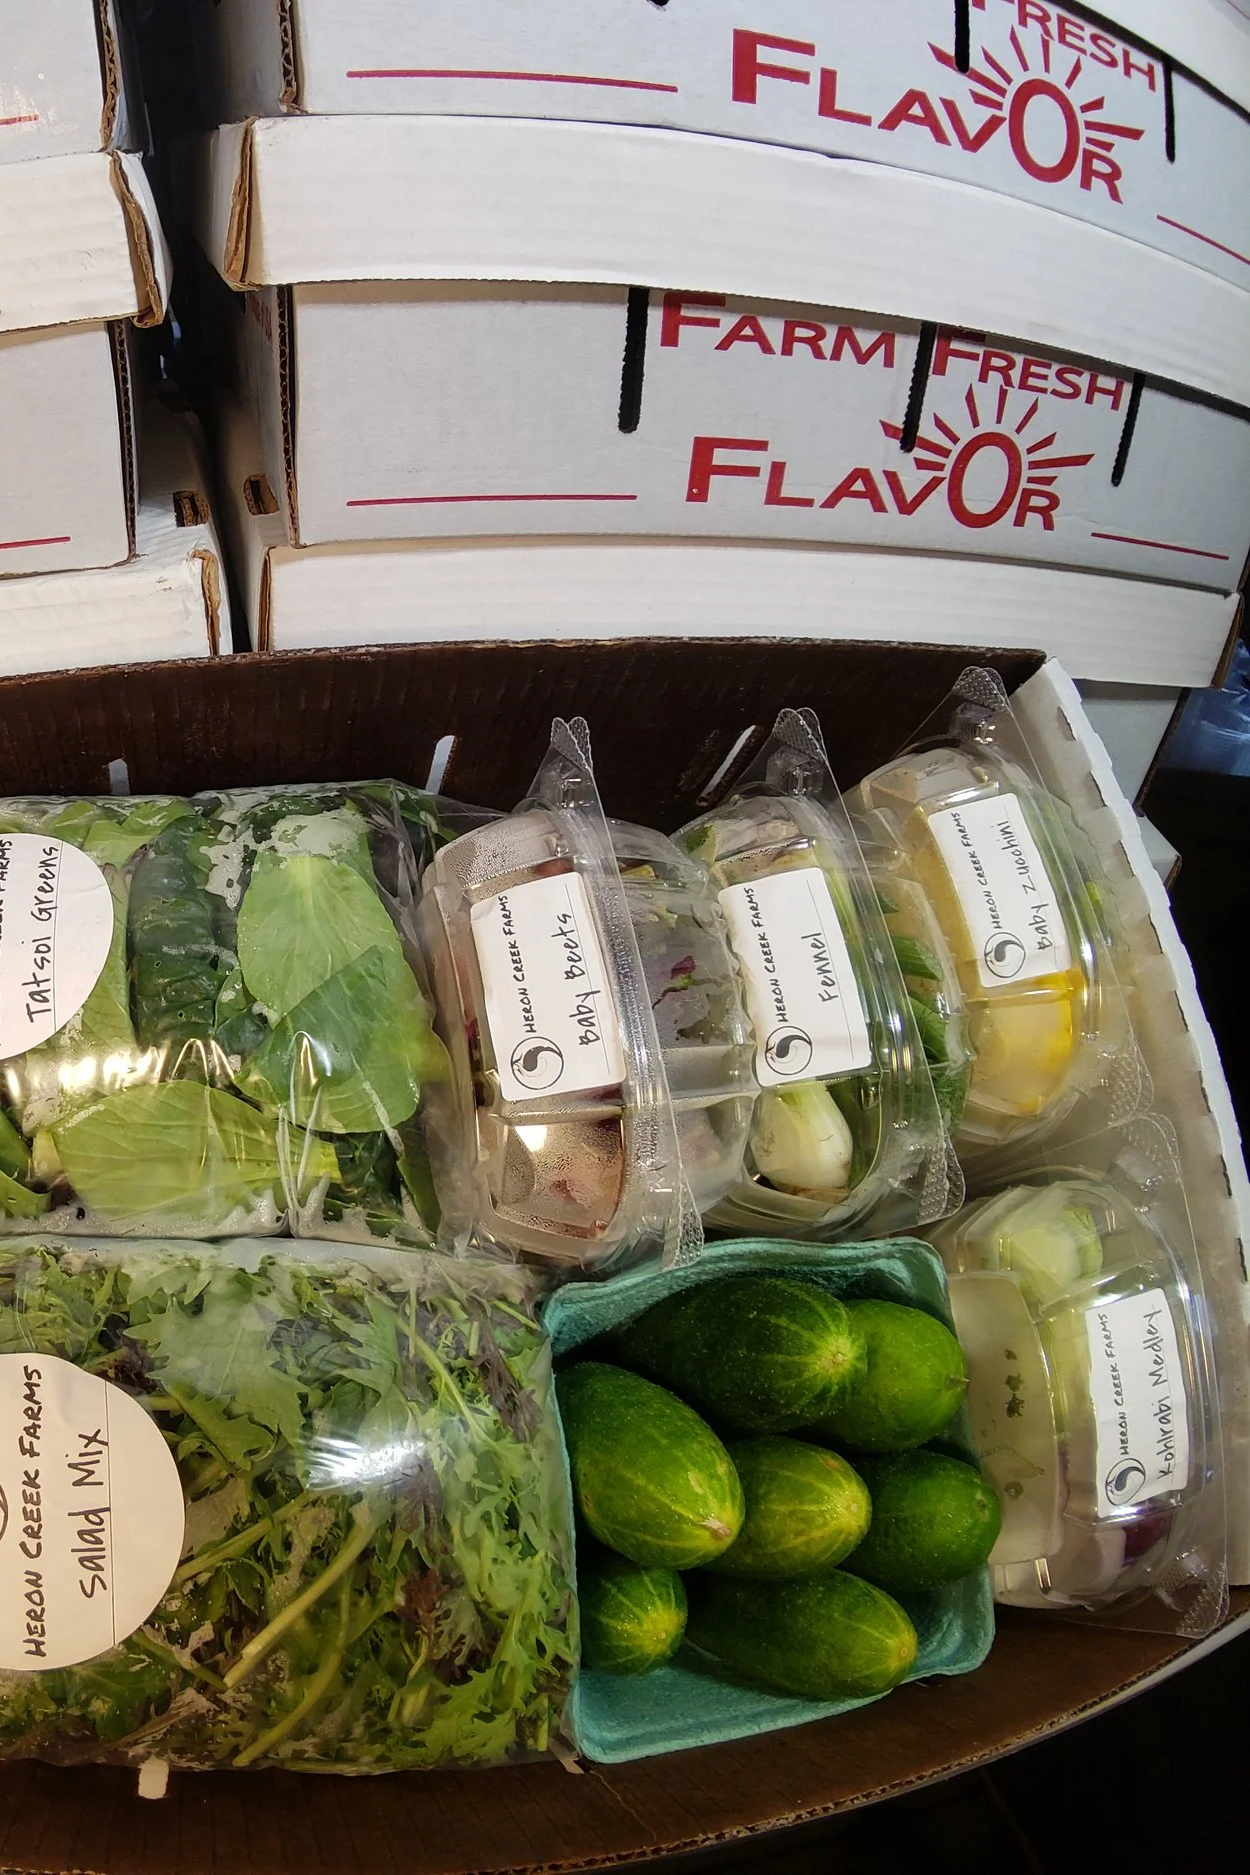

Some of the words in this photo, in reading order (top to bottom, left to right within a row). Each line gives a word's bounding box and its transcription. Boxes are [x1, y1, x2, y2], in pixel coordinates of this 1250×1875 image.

[972, 0, 1156, 92] RESH
[730, 28, 1124, 205] FLAVOR
[659, 291, 896, 369] FARM
[931, 327, 1125, 411] FRESH
[686, 431, 1061, 531] FLAVOR
[951, 812, 972, 848] FARMS
[30, 846, 59, 921] Greens
[968, 850, 988, 885] CREEK
[498, 895, 517, 935] FARMS
[744, 887, 765, 928] FARMS
[983, 890, 1003, 929] HERON
[1028, 903, 1054, 950] Baby
[508, 941, 526, 982] CREEK
[551, 913, 585, 980] Beets
[758, 931, 776, 973] CREEK
[517, 987, 537, 1033] HERON
[569, 990, 601, 1045] Baby
[771, 978, 789, 1022] HERON
[1098, 1312, 1116, 1358] FARMS
[1111, 1363, 1125, 1406] CREEK
[18, 1365, 43, 1458] FARMS
[1118, 1412, 1130, 1456] HERON
[65, 1429, 109, 1487] Mix
[19, 1468, 42, 1559] CREEK
[68, 1507, 111, 1599] Salad
[22, 1570, 47, 1657] HERON
